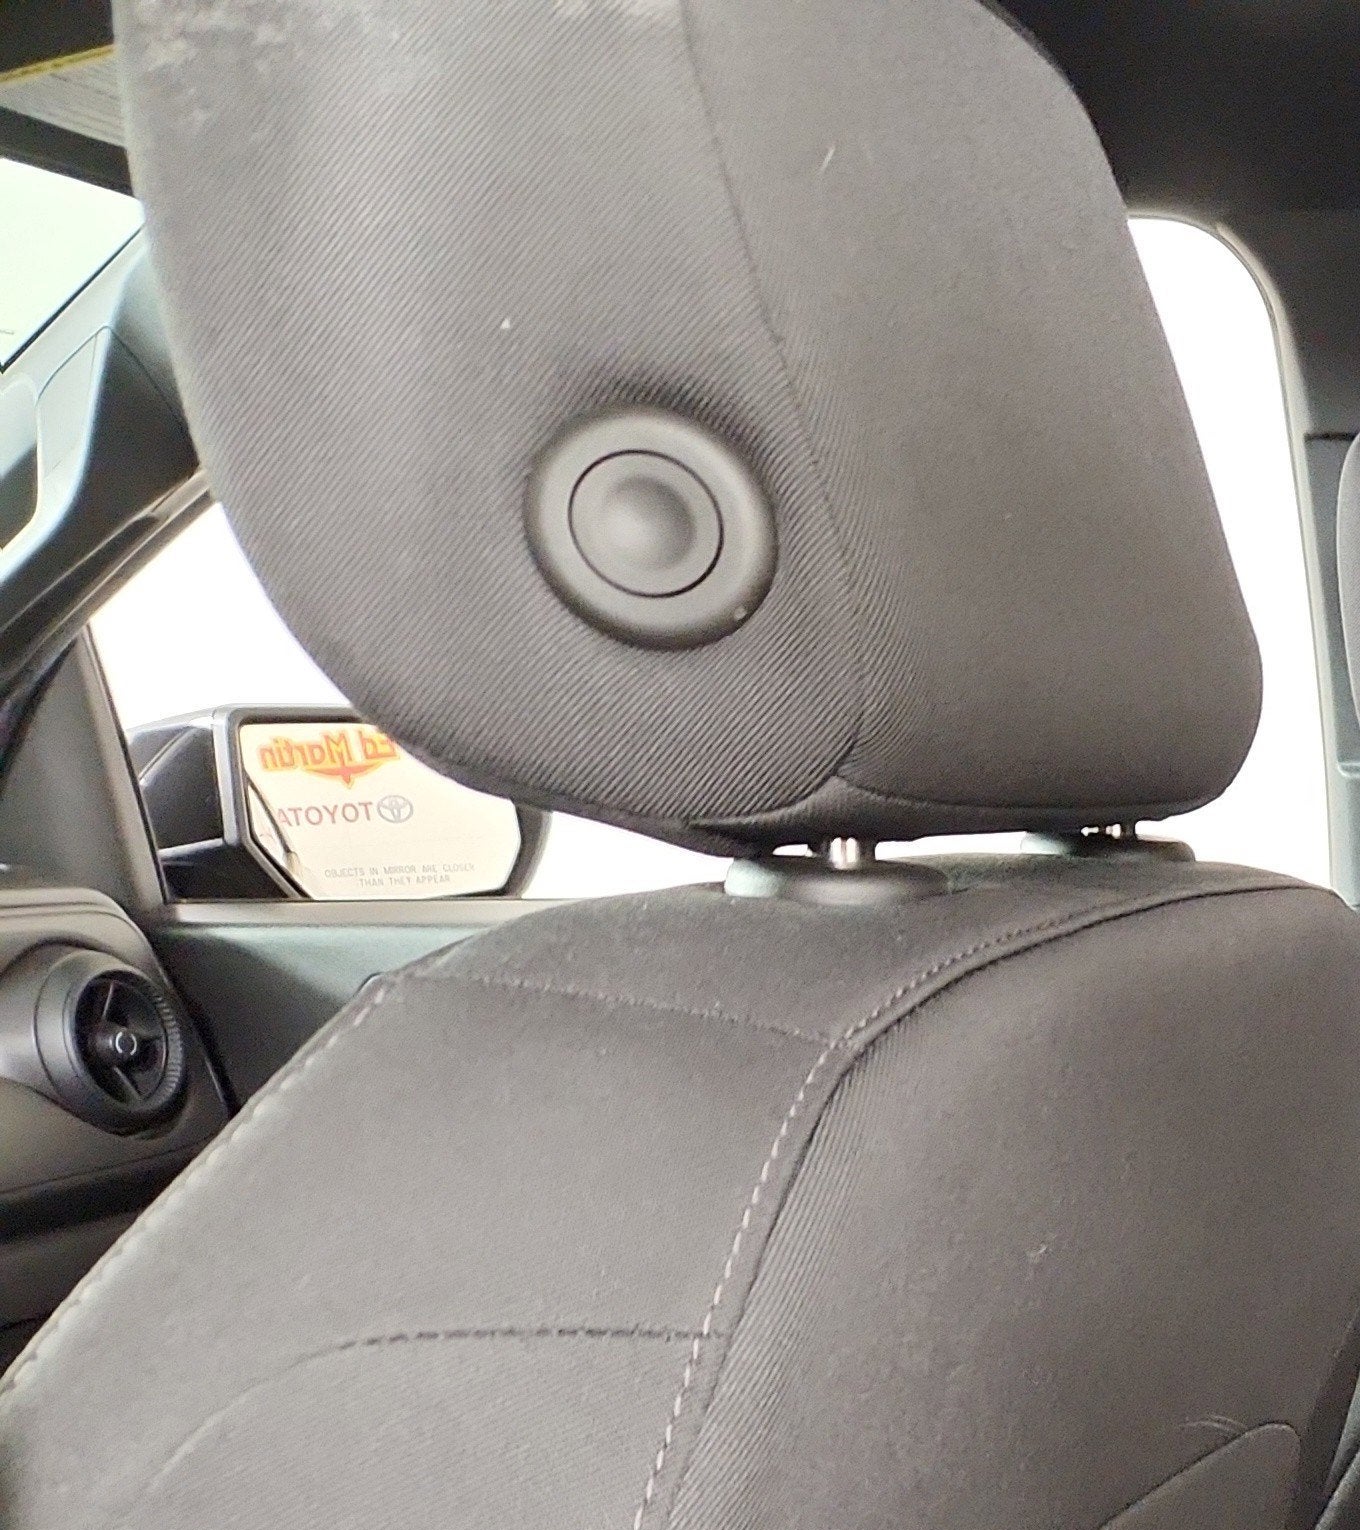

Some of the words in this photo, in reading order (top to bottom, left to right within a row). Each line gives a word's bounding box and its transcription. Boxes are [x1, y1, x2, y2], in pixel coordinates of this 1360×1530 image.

[324, 867, 365, 878] OBJECTS
[369, 866, 379, 876] IN
[383, 864, 416, 875] MIRROR
[422, 864, 438, 874] ARE
[359, 877, 384, 888] THAN
[389, 876, 412, 886] THEY
[416, 874, 451, 885] APPEAR
